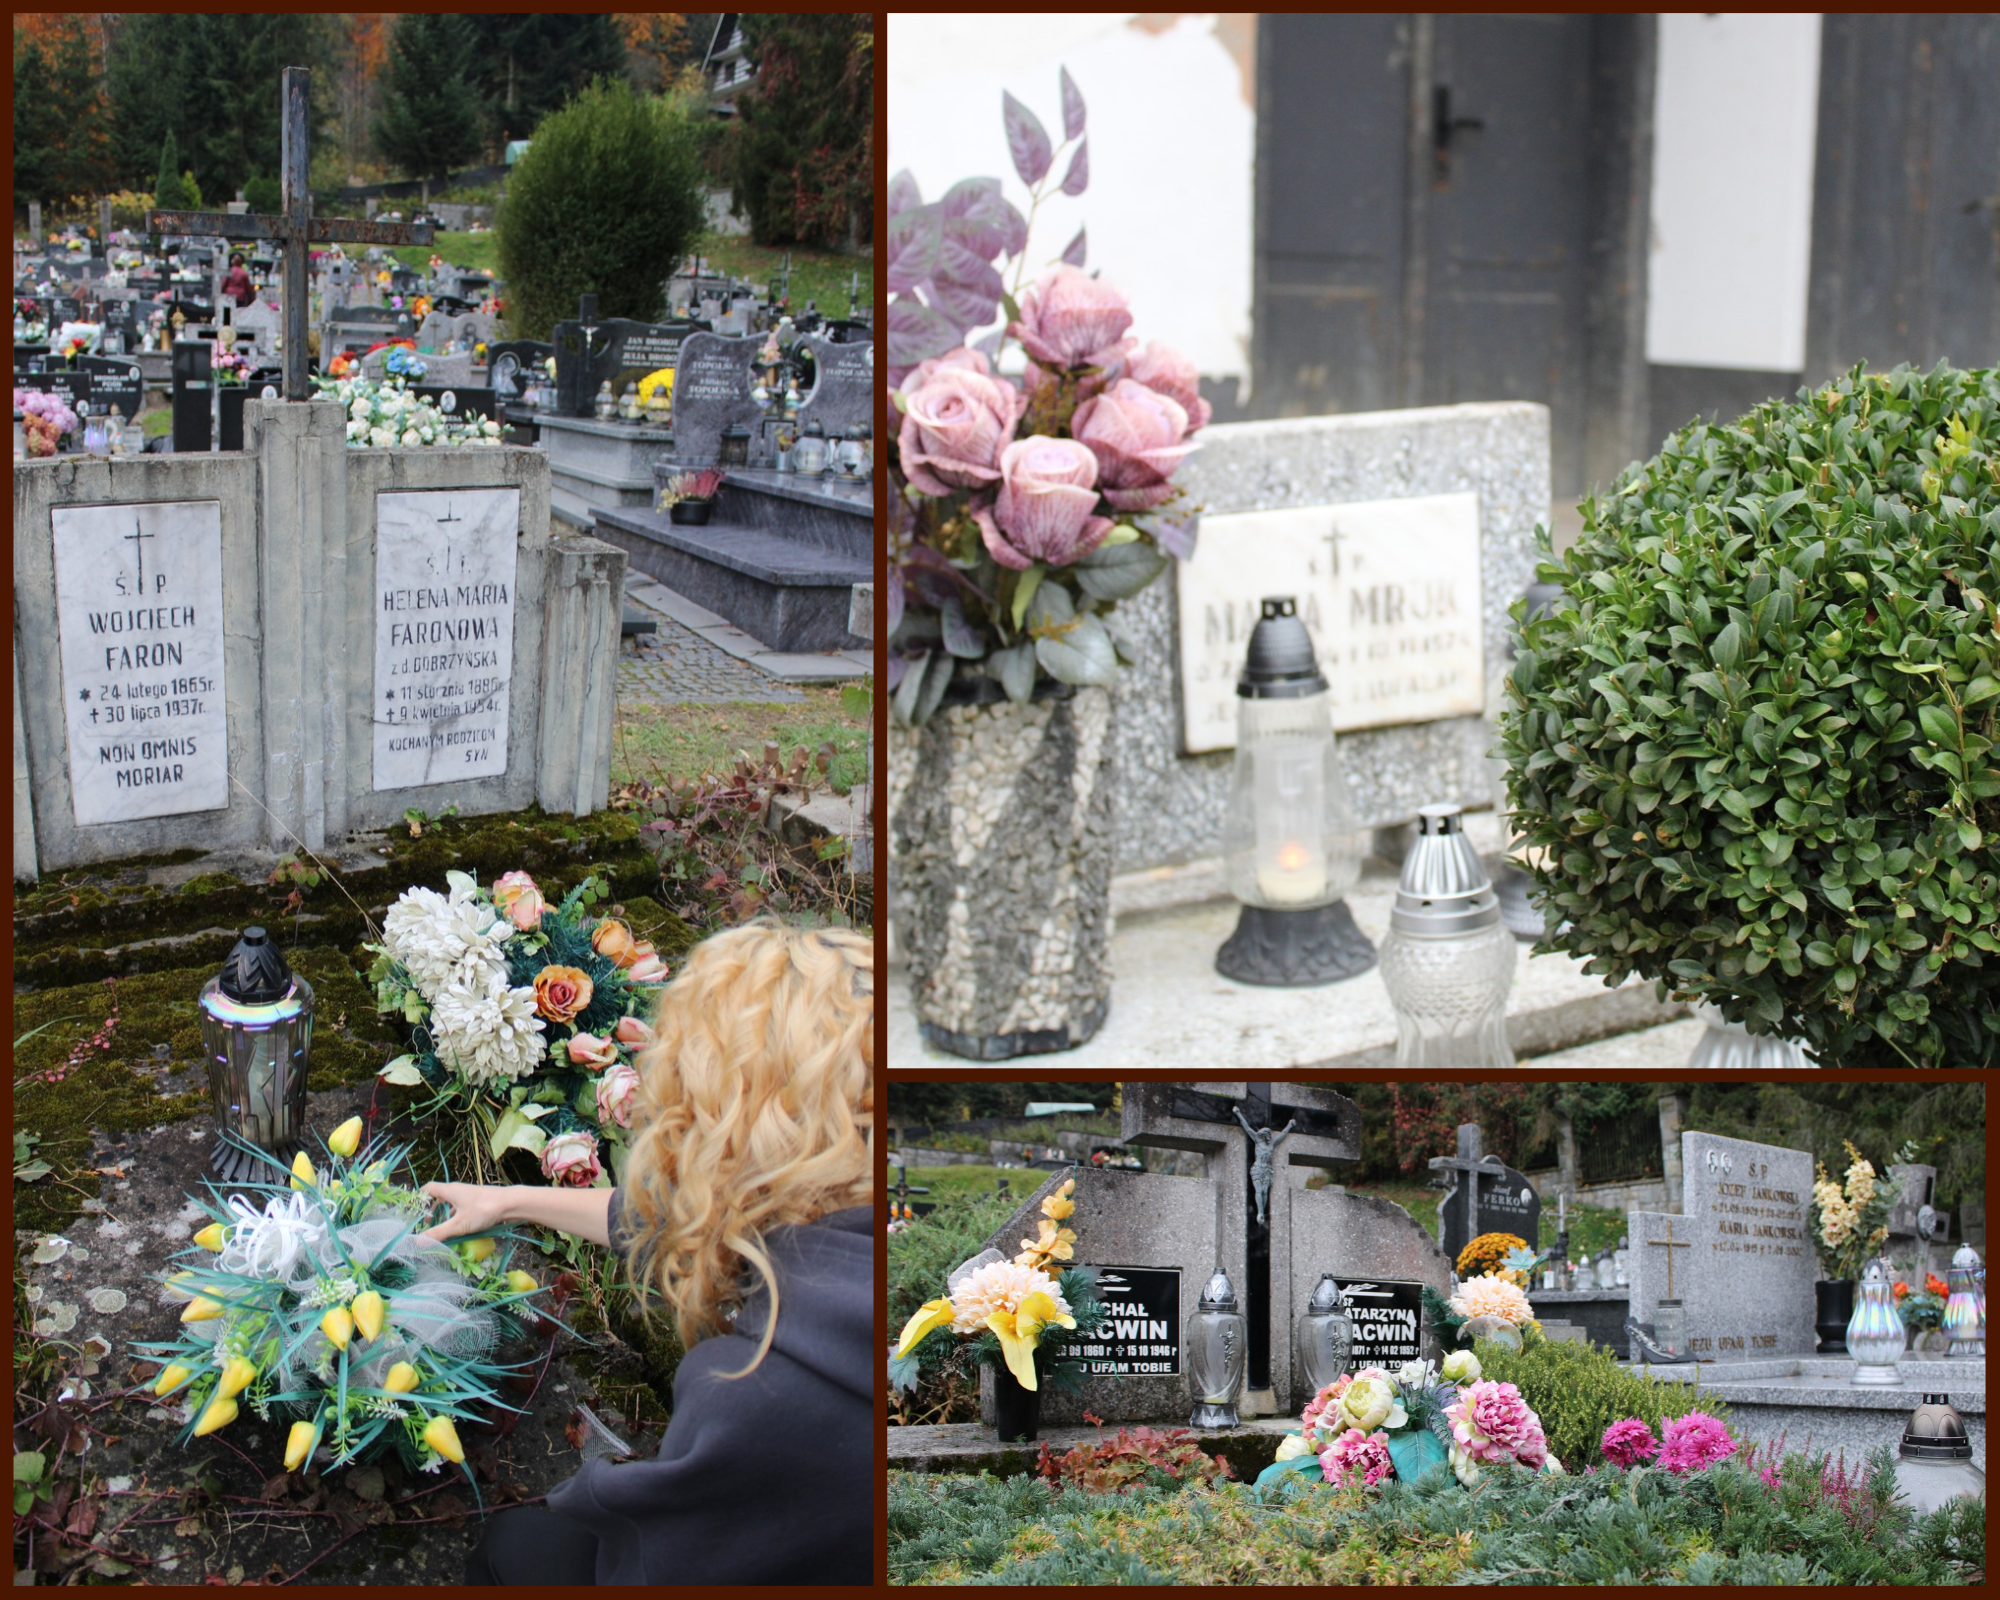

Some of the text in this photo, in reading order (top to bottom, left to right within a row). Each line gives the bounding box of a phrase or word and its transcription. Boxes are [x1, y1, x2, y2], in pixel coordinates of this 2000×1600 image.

[384, 584, 508, 611] HELENA MARIA
[89, 606, 195, 634] WOJCIECH
[392, 617, 498, 646] FARONOWA
[106, 641, 182, 670] FARON
[100, 684, 122, 701] 24
[128, 682, 168, 699] lutego
[106, 699, 206, 723] 30 lipca 1937r.
[413, 702, 460, 720] kwietnia
[389, 728, 496, 752] KOCHANYM RODZICOM
[100, 736, 196, 764] NON OMNIS
[466, 748, 488, 762] SYN
[117, 764, 183, 788] MORIAR
[1484, 1193, 1520, 1207] FERKO
[1752, 1186, 1799, 1204] JANKOWSKI
[1718, 1220, 1802, 1240] MARIA JANKOWSKA
[1087, 1301, 1149, 1316] CHAŁ
[1344, 1308, 1416, 1321] ATARZYNA
[1352, 1324, 1416, 1341] ACWIN
[1083, 1344, 1104, 1356] 1860
[1127, 1345, 1136, 1356] 15
[1138, 1345, 1148, 1356] 10
[1150, 1345, 1170, 1356] 1946
[1688, 1334, 1778, 1352] JEZU UFAM TOBIE
[1092, 1362, 1128, 1373] UFAM
[1132, 1362, 1172, 1373] TOBIE
[1358, 1360, 1386, 1370] UFAM
